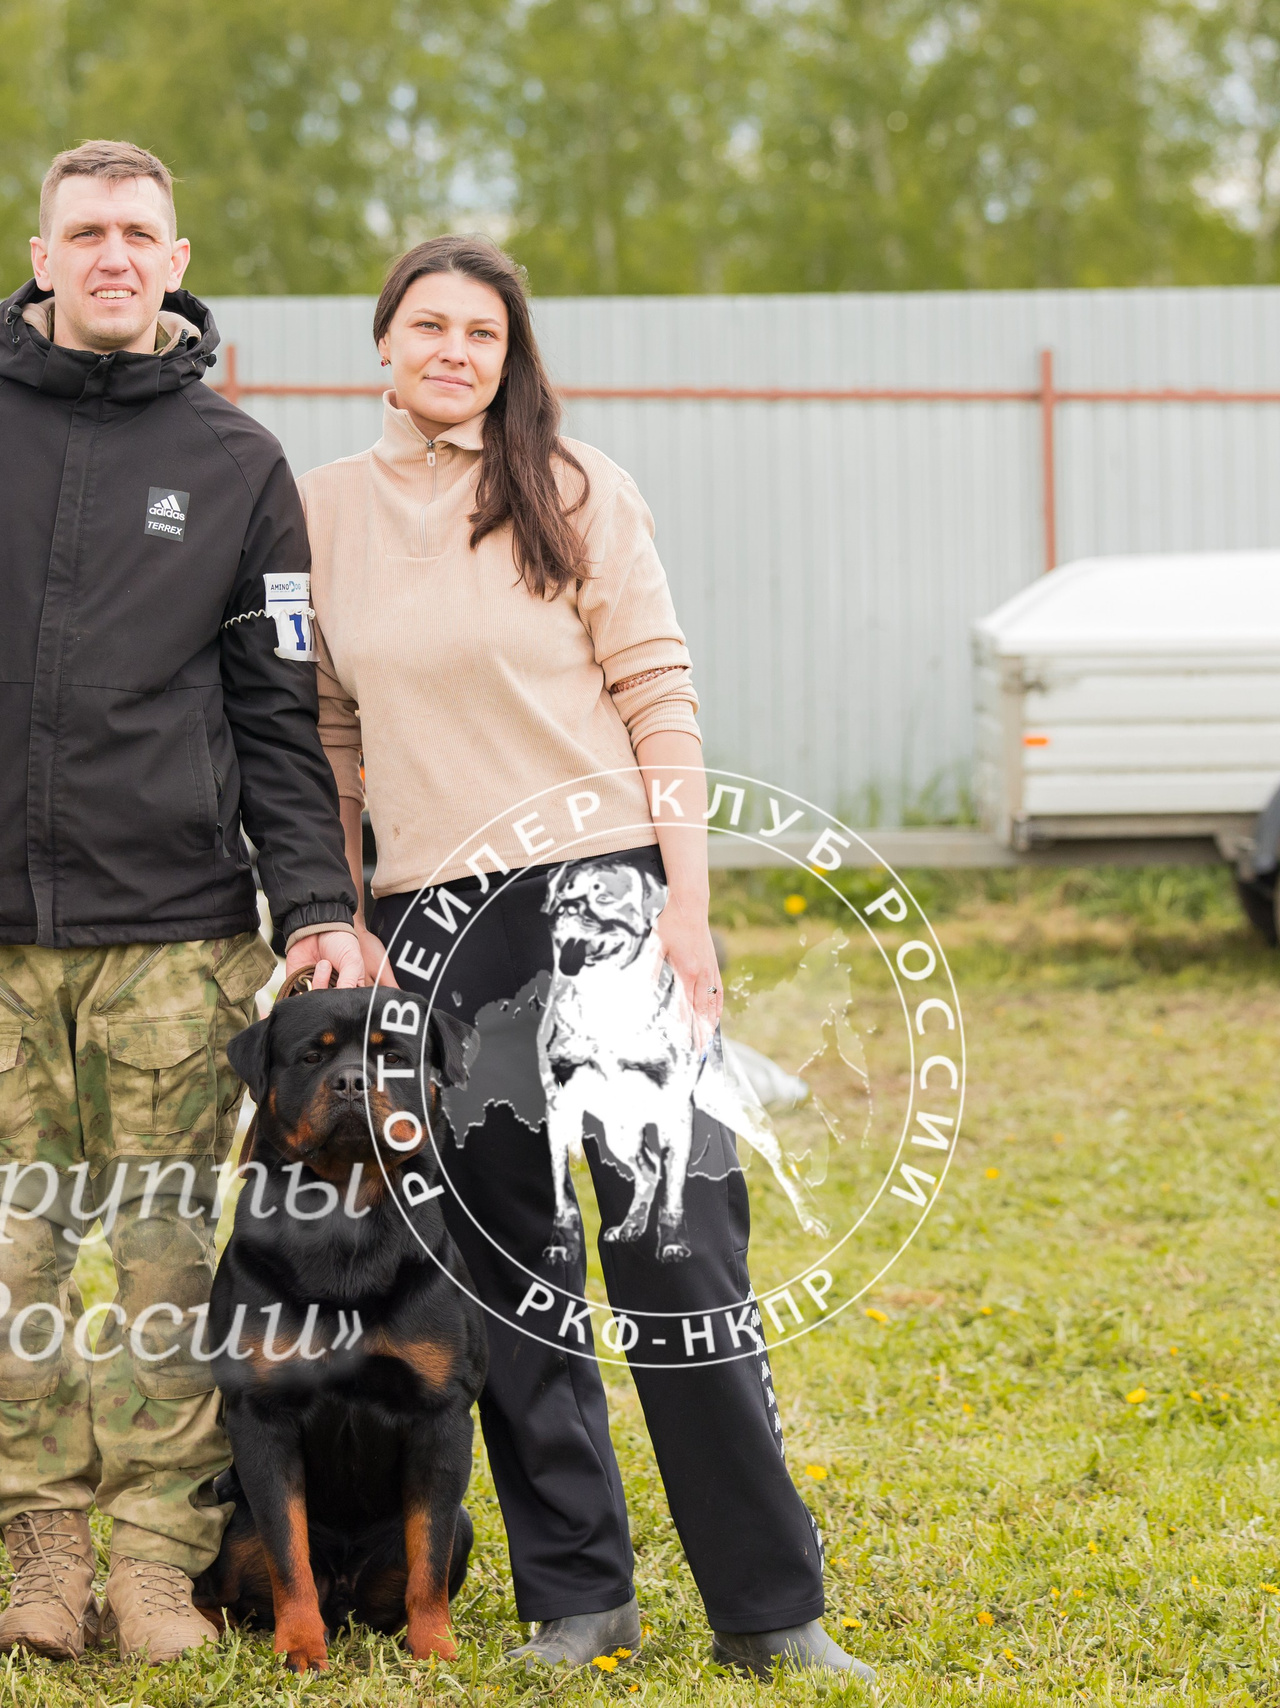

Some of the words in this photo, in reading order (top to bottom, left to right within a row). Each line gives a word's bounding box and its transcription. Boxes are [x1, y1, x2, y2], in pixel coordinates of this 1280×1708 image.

[149, 507, 186, 521] adidas
[147, 521, 183, 536] TERREX
[289, 613, 306, 651] 1
